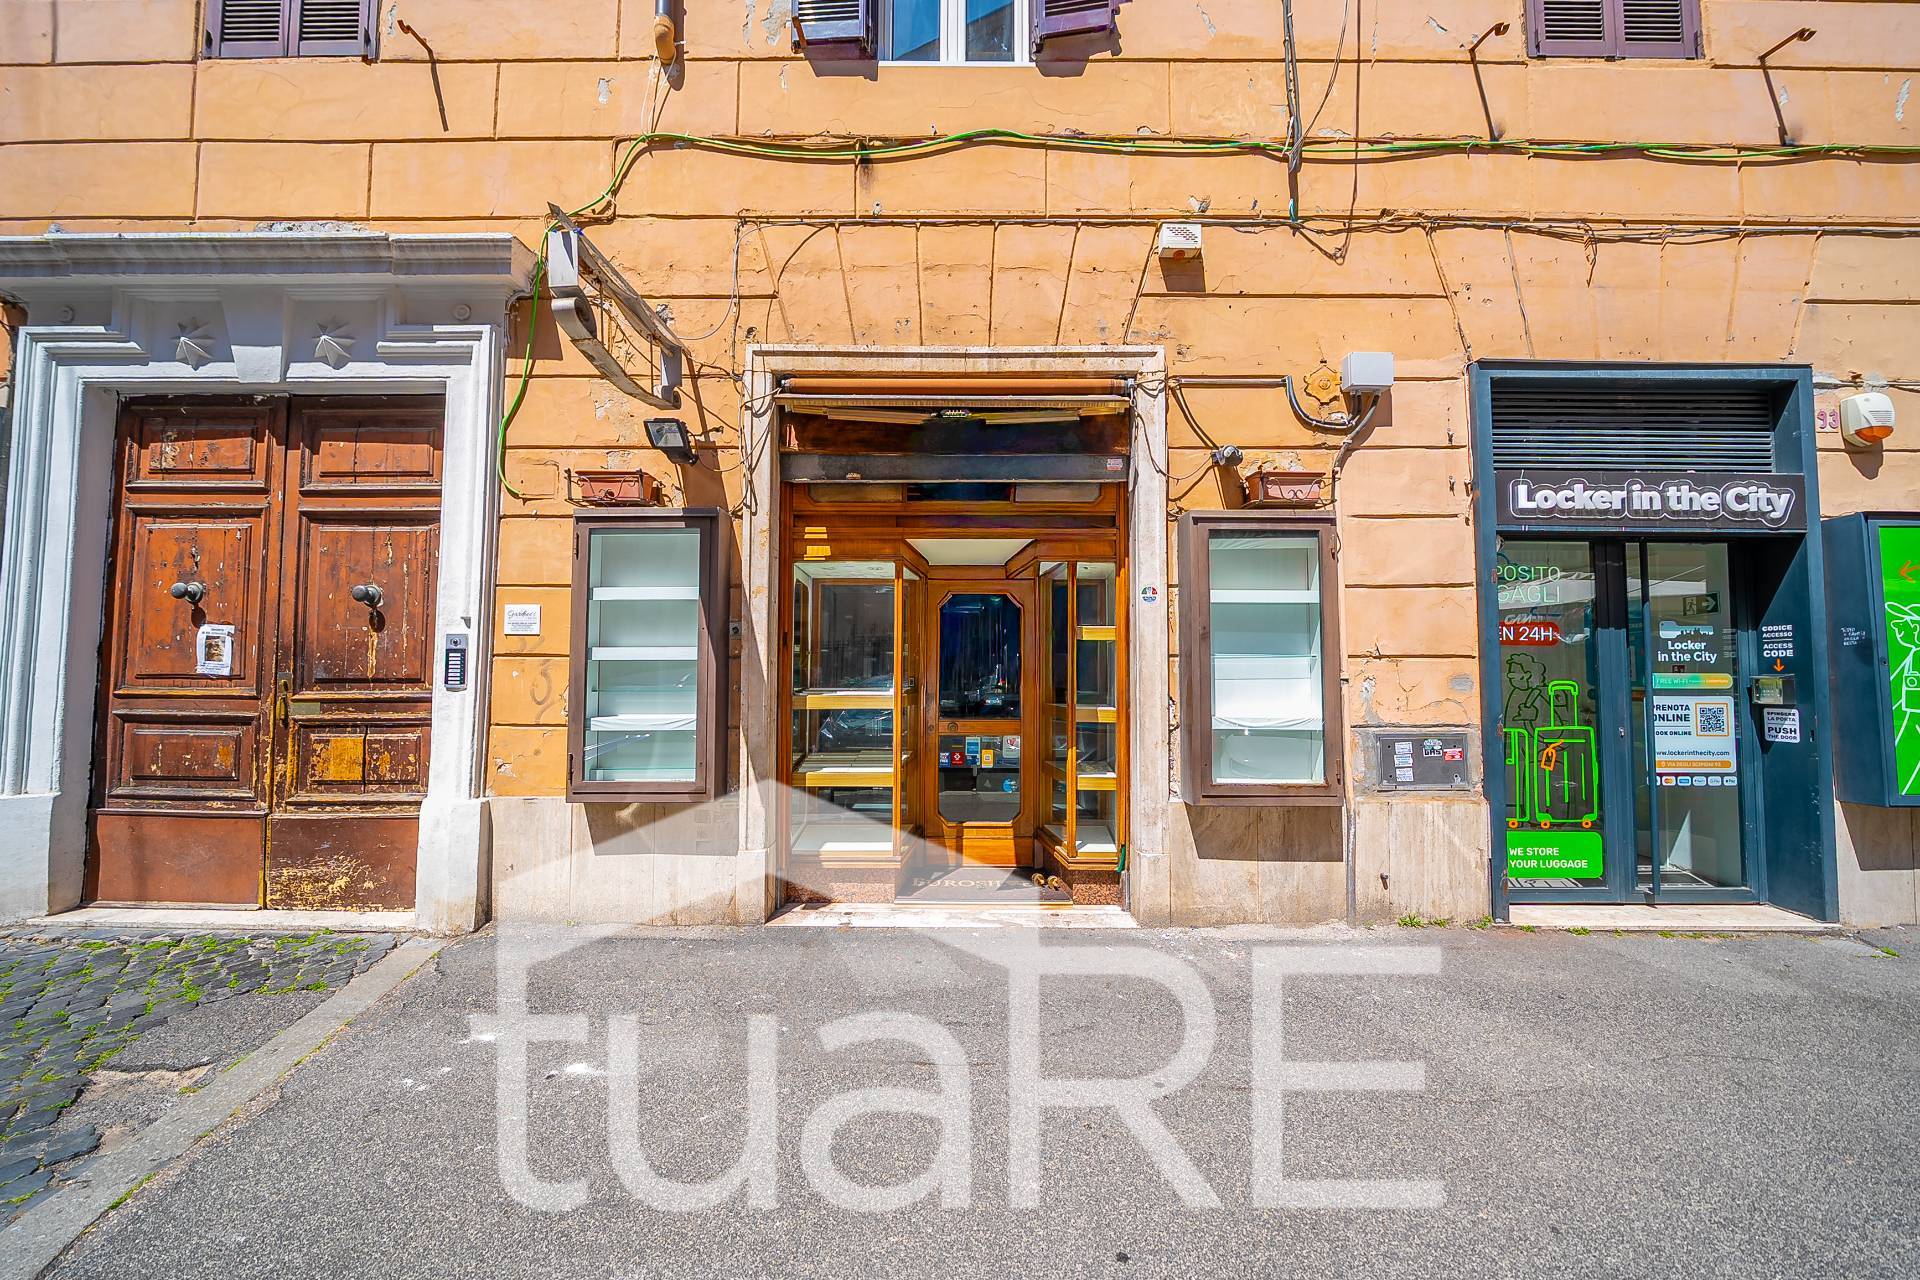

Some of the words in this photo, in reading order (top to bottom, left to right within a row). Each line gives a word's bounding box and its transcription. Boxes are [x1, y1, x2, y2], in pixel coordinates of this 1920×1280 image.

[1817, 409, 1839, 429] 93
[1518, 483, 1627, 510] Locker
[1632, 484, 1662, 510] in
[1667, 485, 1720, 511] the
[1726, 486, 1791, 519] City
[1519, 626, 1553, 641] 24H
[1667, 640, 1706, 650] Locker
[1657, 651, 1669, 662] in
[1671, 651, 1691, 662] the
[1693, 651, 1717, 664] City
[1767, 726, 1797, 735] PUSH
[1509, 847, 1524, 856] WE
[1526, 847, 1560, 856] STORE
[1509, 859, 1538, 869] YOUR
[1540, 859, 1588, 869] LUGGAGE
